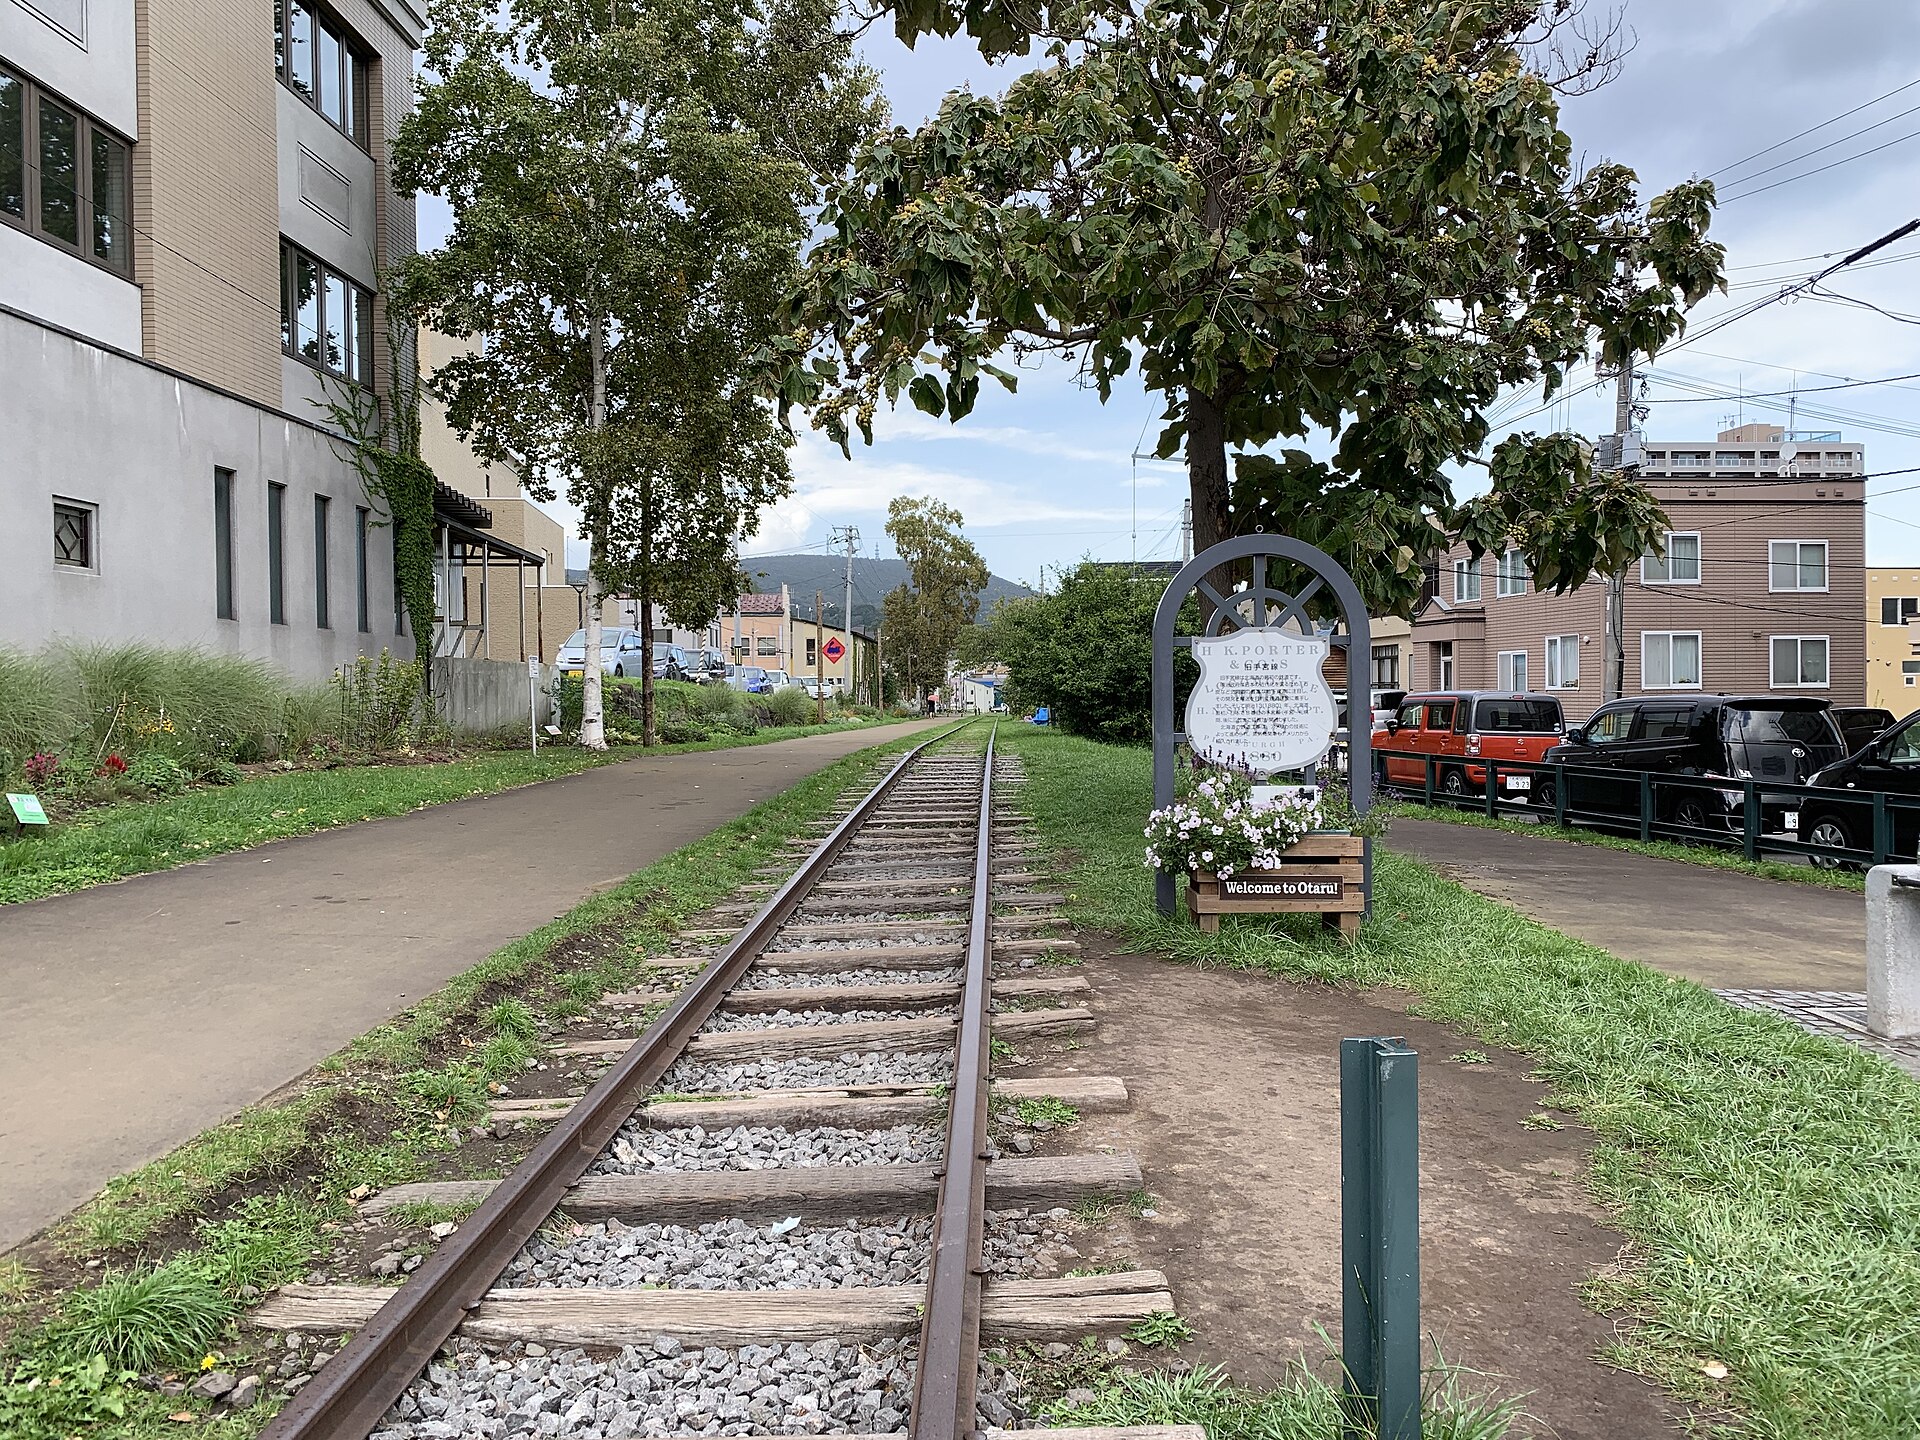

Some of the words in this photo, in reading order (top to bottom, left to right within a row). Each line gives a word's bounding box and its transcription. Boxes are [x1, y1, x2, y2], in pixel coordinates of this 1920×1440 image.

[1201, 646, 1212, 656] H
[1225, 881, 1282, 894] Welcome
[1283, 881, 1297, 894] to
[1297, 881, 1338, 895] Otaru!
